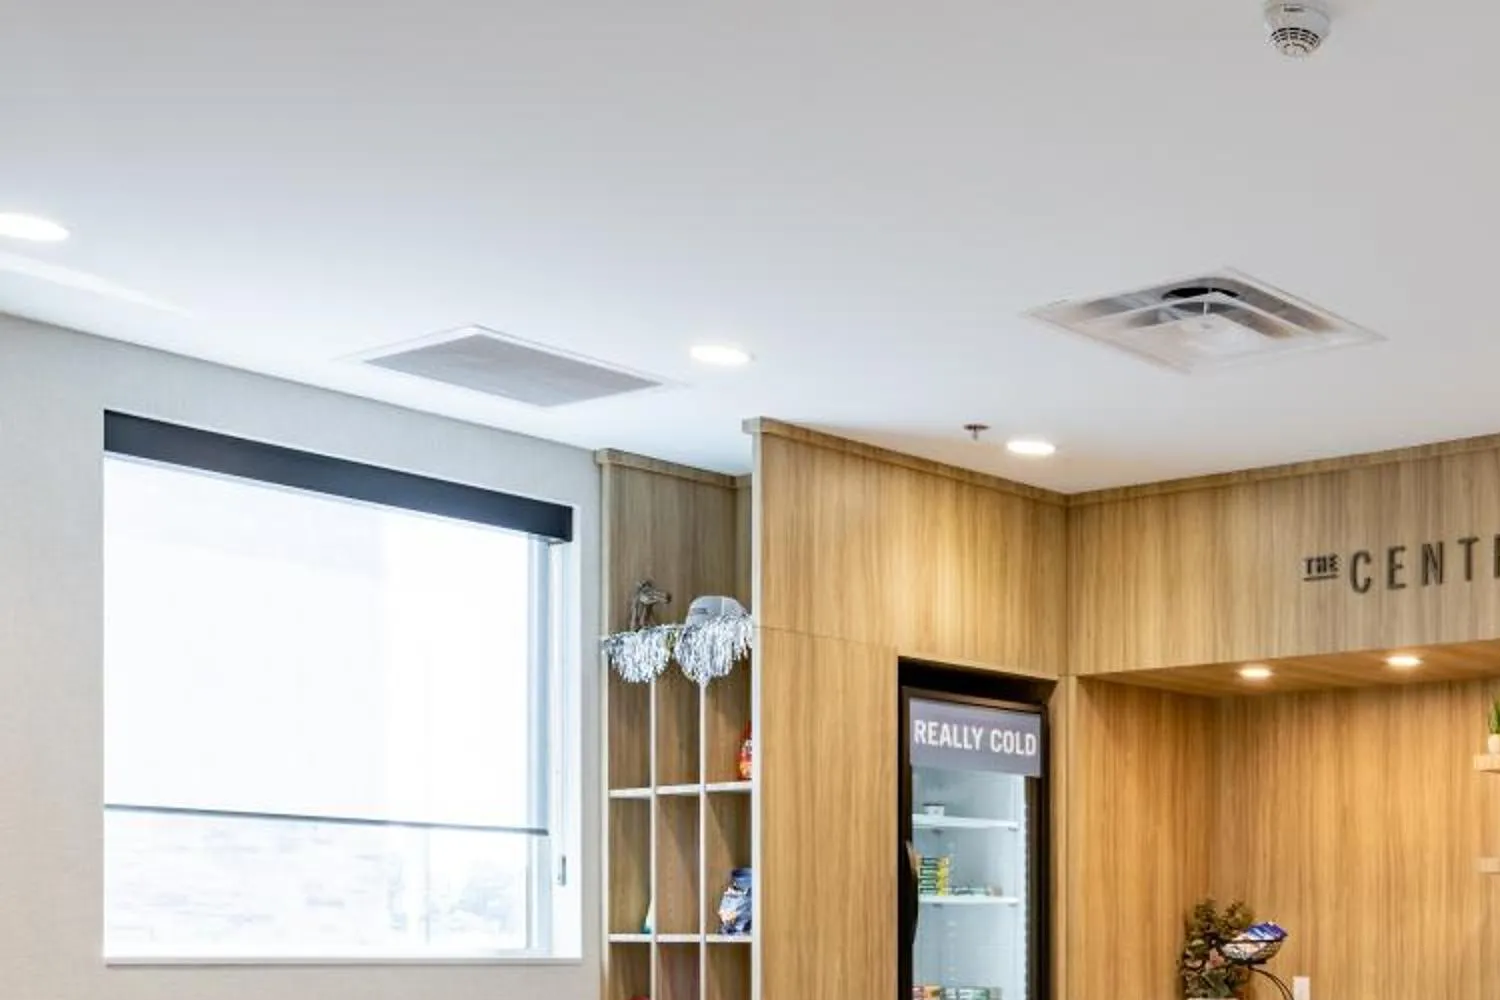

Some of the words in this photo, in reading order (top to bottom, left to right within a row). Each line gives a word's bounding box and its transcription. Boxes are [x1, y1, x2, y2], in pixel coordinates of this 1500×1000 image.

[1304, 554, 1339, 575] THE
[914, 719, 984, 750] REALLY
[991, 729, 1037, 756] COLD
